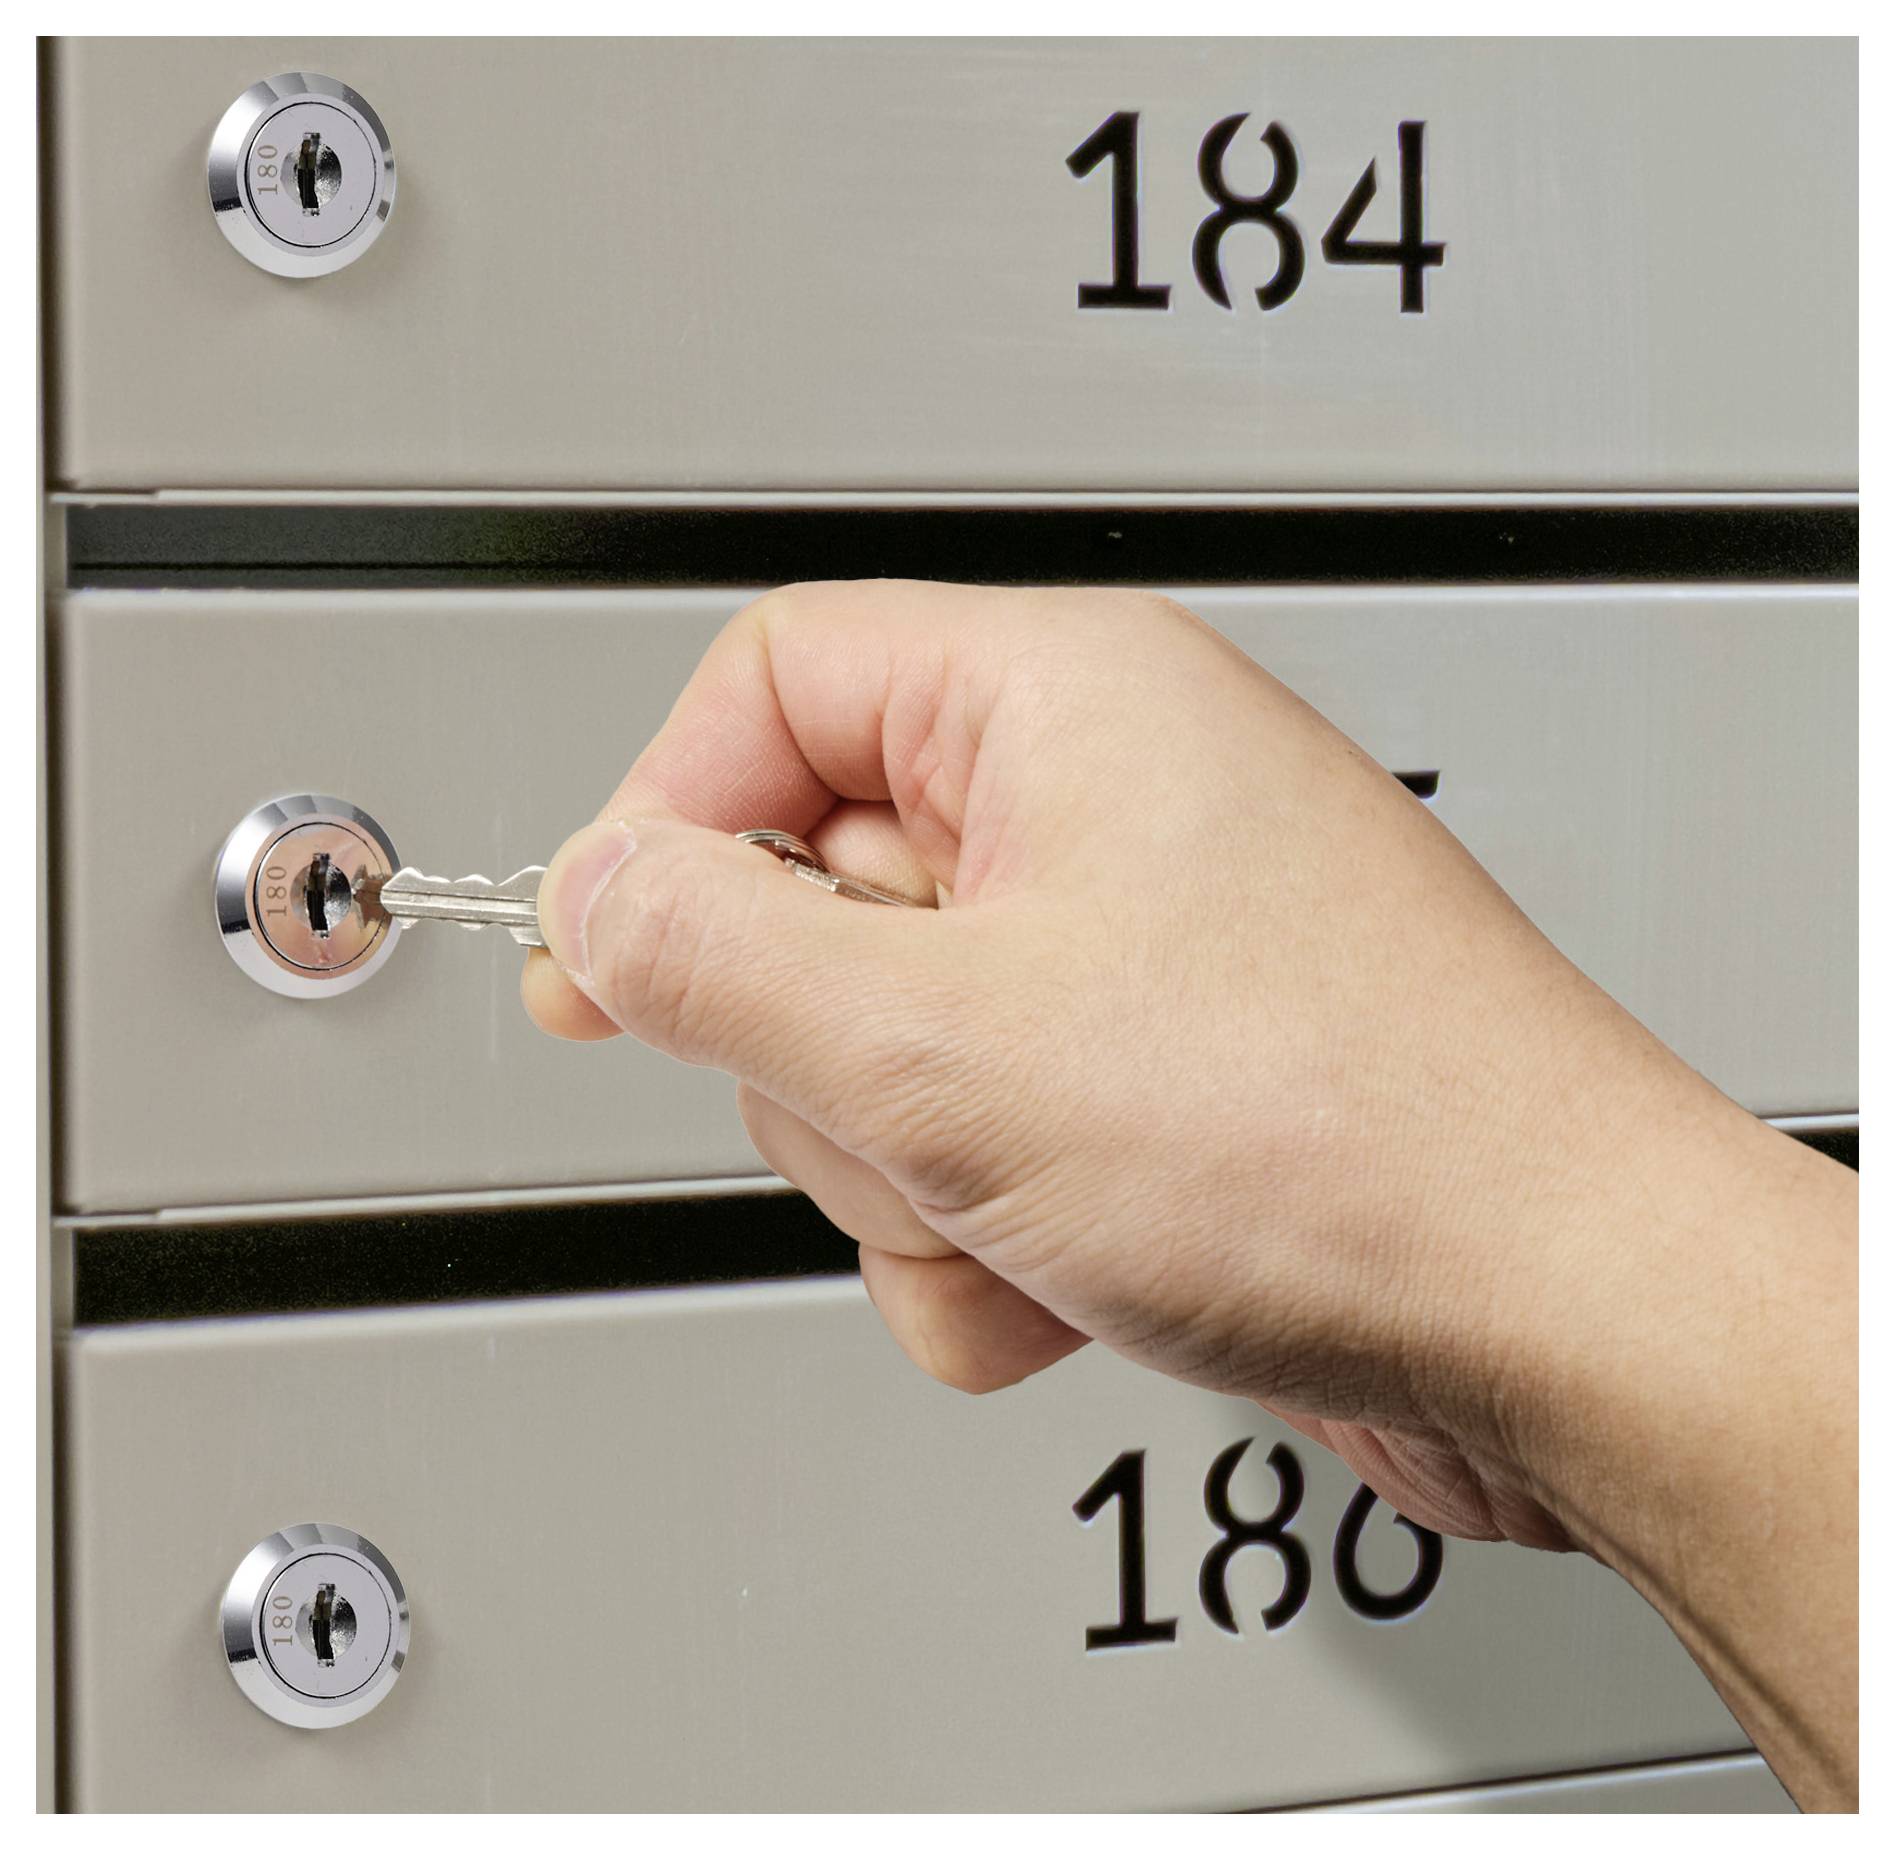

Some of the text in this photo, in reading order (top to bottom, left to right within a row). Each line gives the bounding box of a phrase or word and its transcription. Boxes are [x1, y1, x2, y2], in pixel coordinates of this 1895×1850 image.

[257, 144, 278, 195] 180
[1065, 112, 1446, 314] 184
[265, 865, 287, 917] 180
[1072, 1437, 1444, 1652] 186
[272, 1595, 293, 1646] 180
